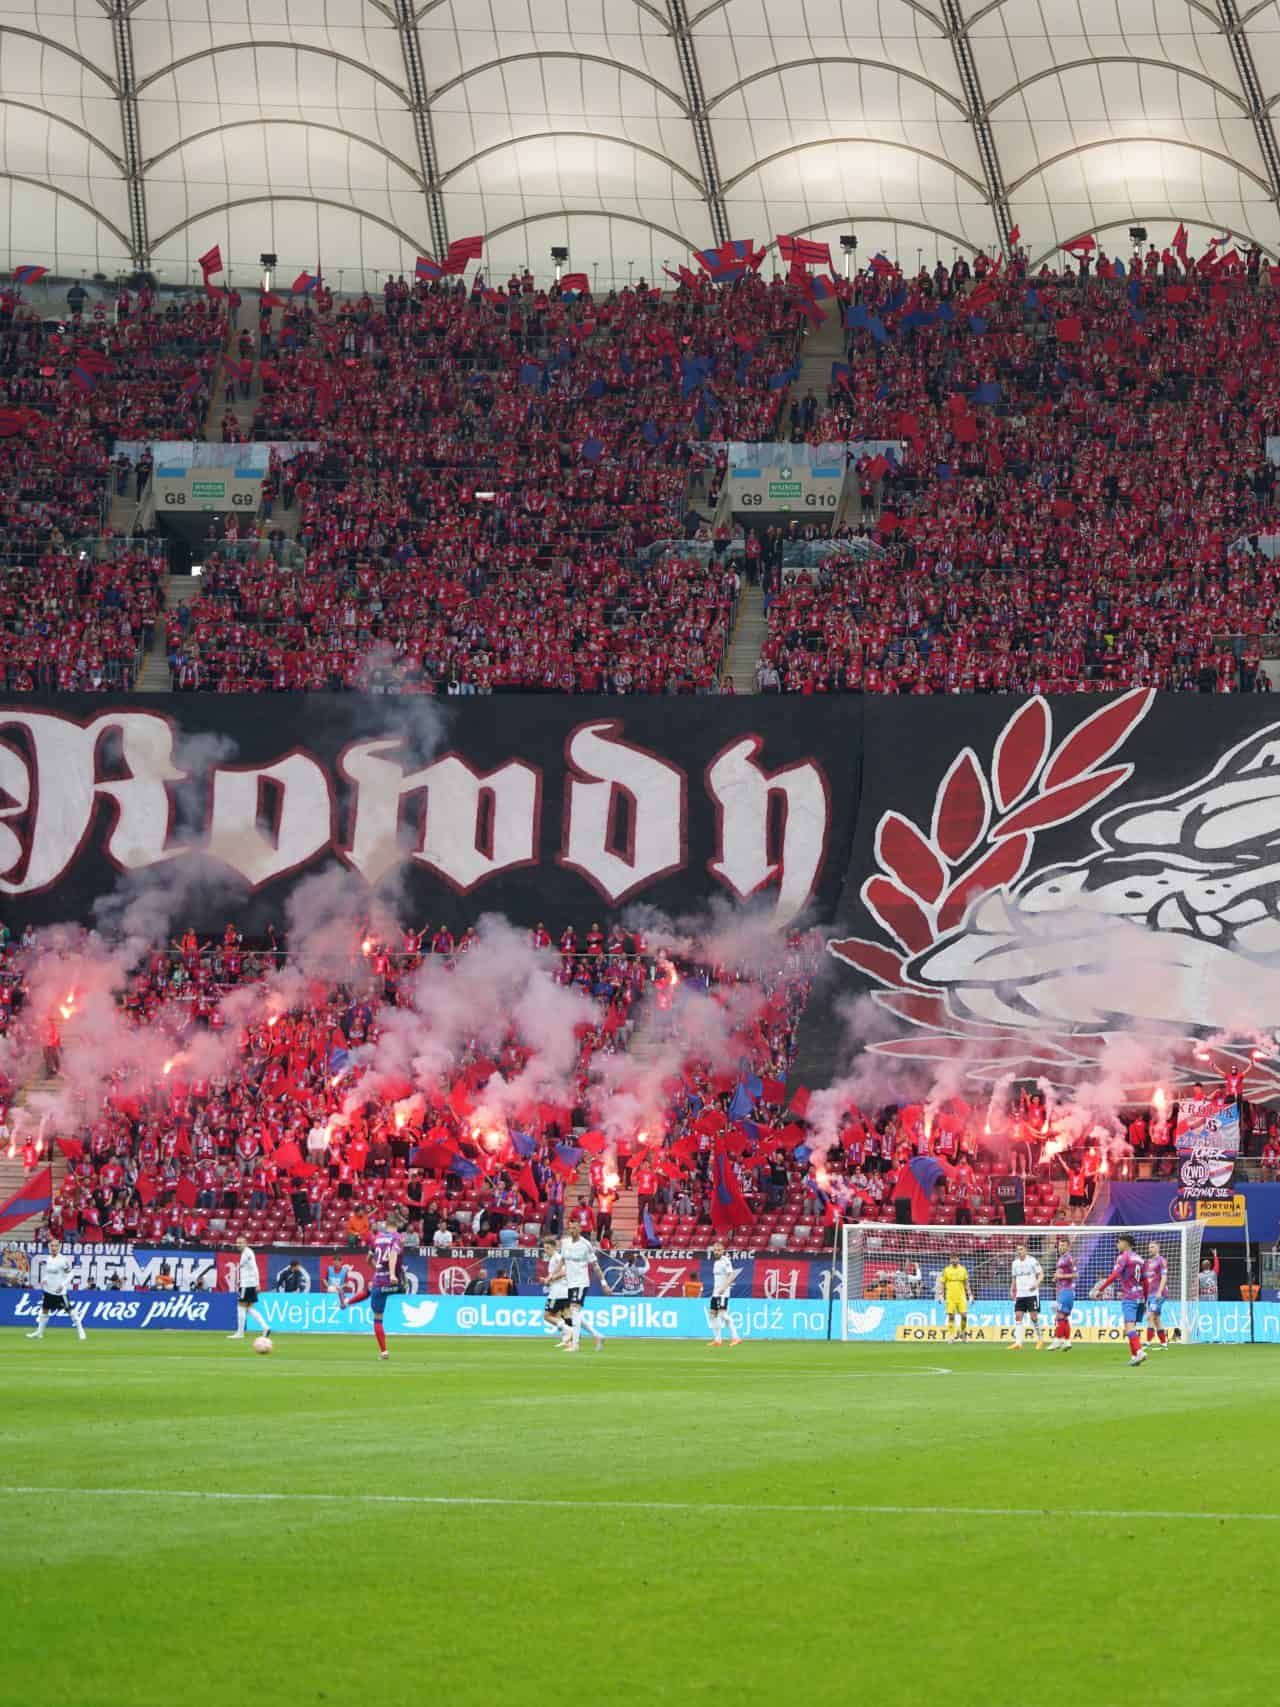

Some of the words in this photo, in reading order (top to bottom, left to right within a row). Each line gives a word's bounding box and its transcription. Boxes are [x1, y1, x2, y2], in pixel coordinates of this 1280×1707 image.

[165, 493, 186, 505] G8
[232, 494, 253, 505] G9
[742, 494, 763, 506] G9
[805, 494, 837, 506] G10
[59, 1243, 135, 1256] ROGOWIE
[93, 1300, 140, 1321] nas
[141, 1295, 210, 1328] piłka
[263, 1299, 340, 1329] Wejdź
[793, 1311, 825, 1330] na
